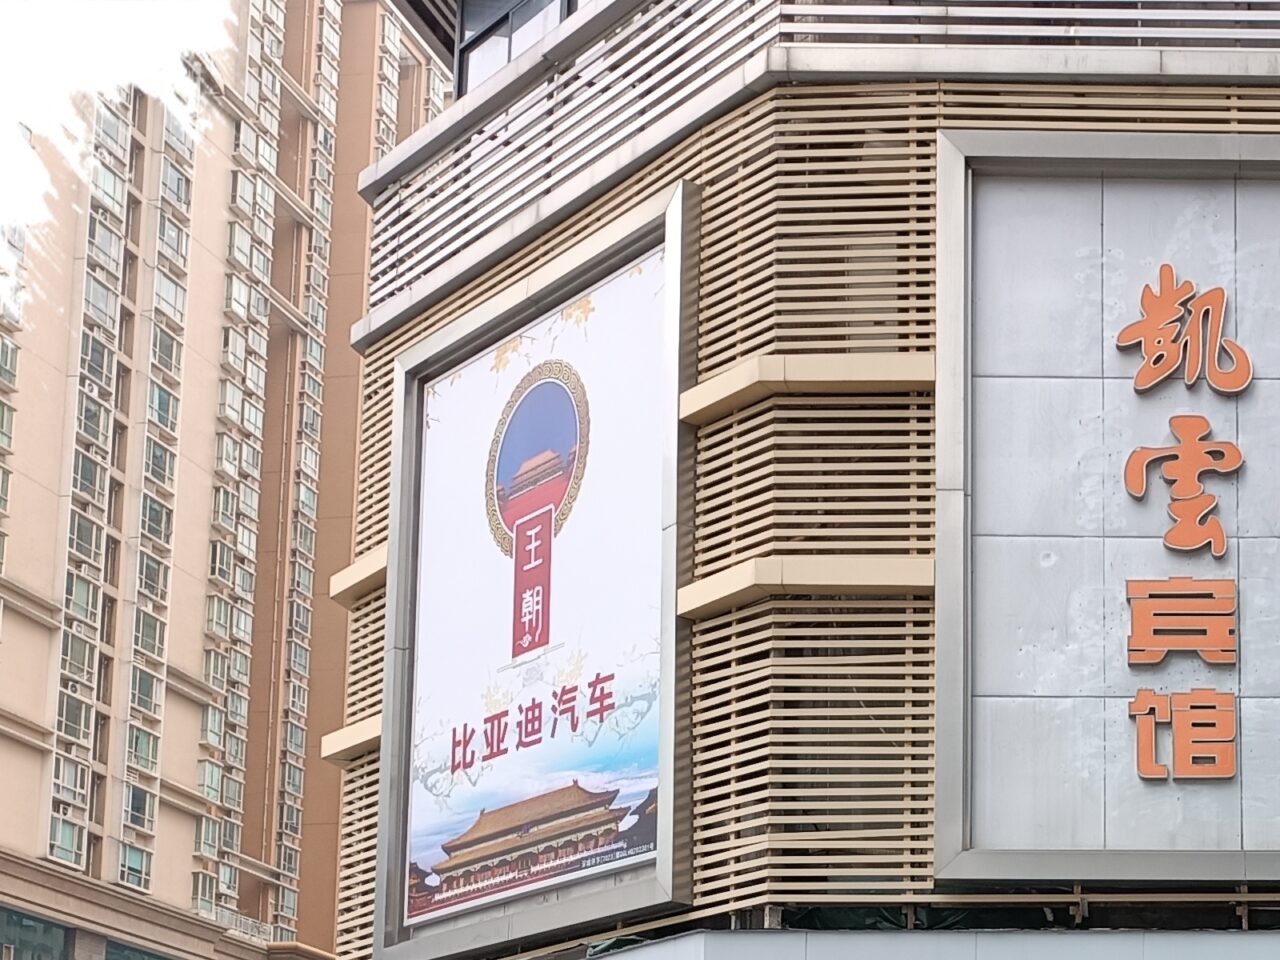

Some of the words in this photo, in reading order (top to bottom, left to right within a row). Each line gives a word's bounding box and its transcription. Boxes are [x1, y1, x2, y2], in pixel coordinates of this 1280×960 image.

[520, 524, 544, 643] 王朝
[450, 672, 615, 775] 比亚迪汽车
